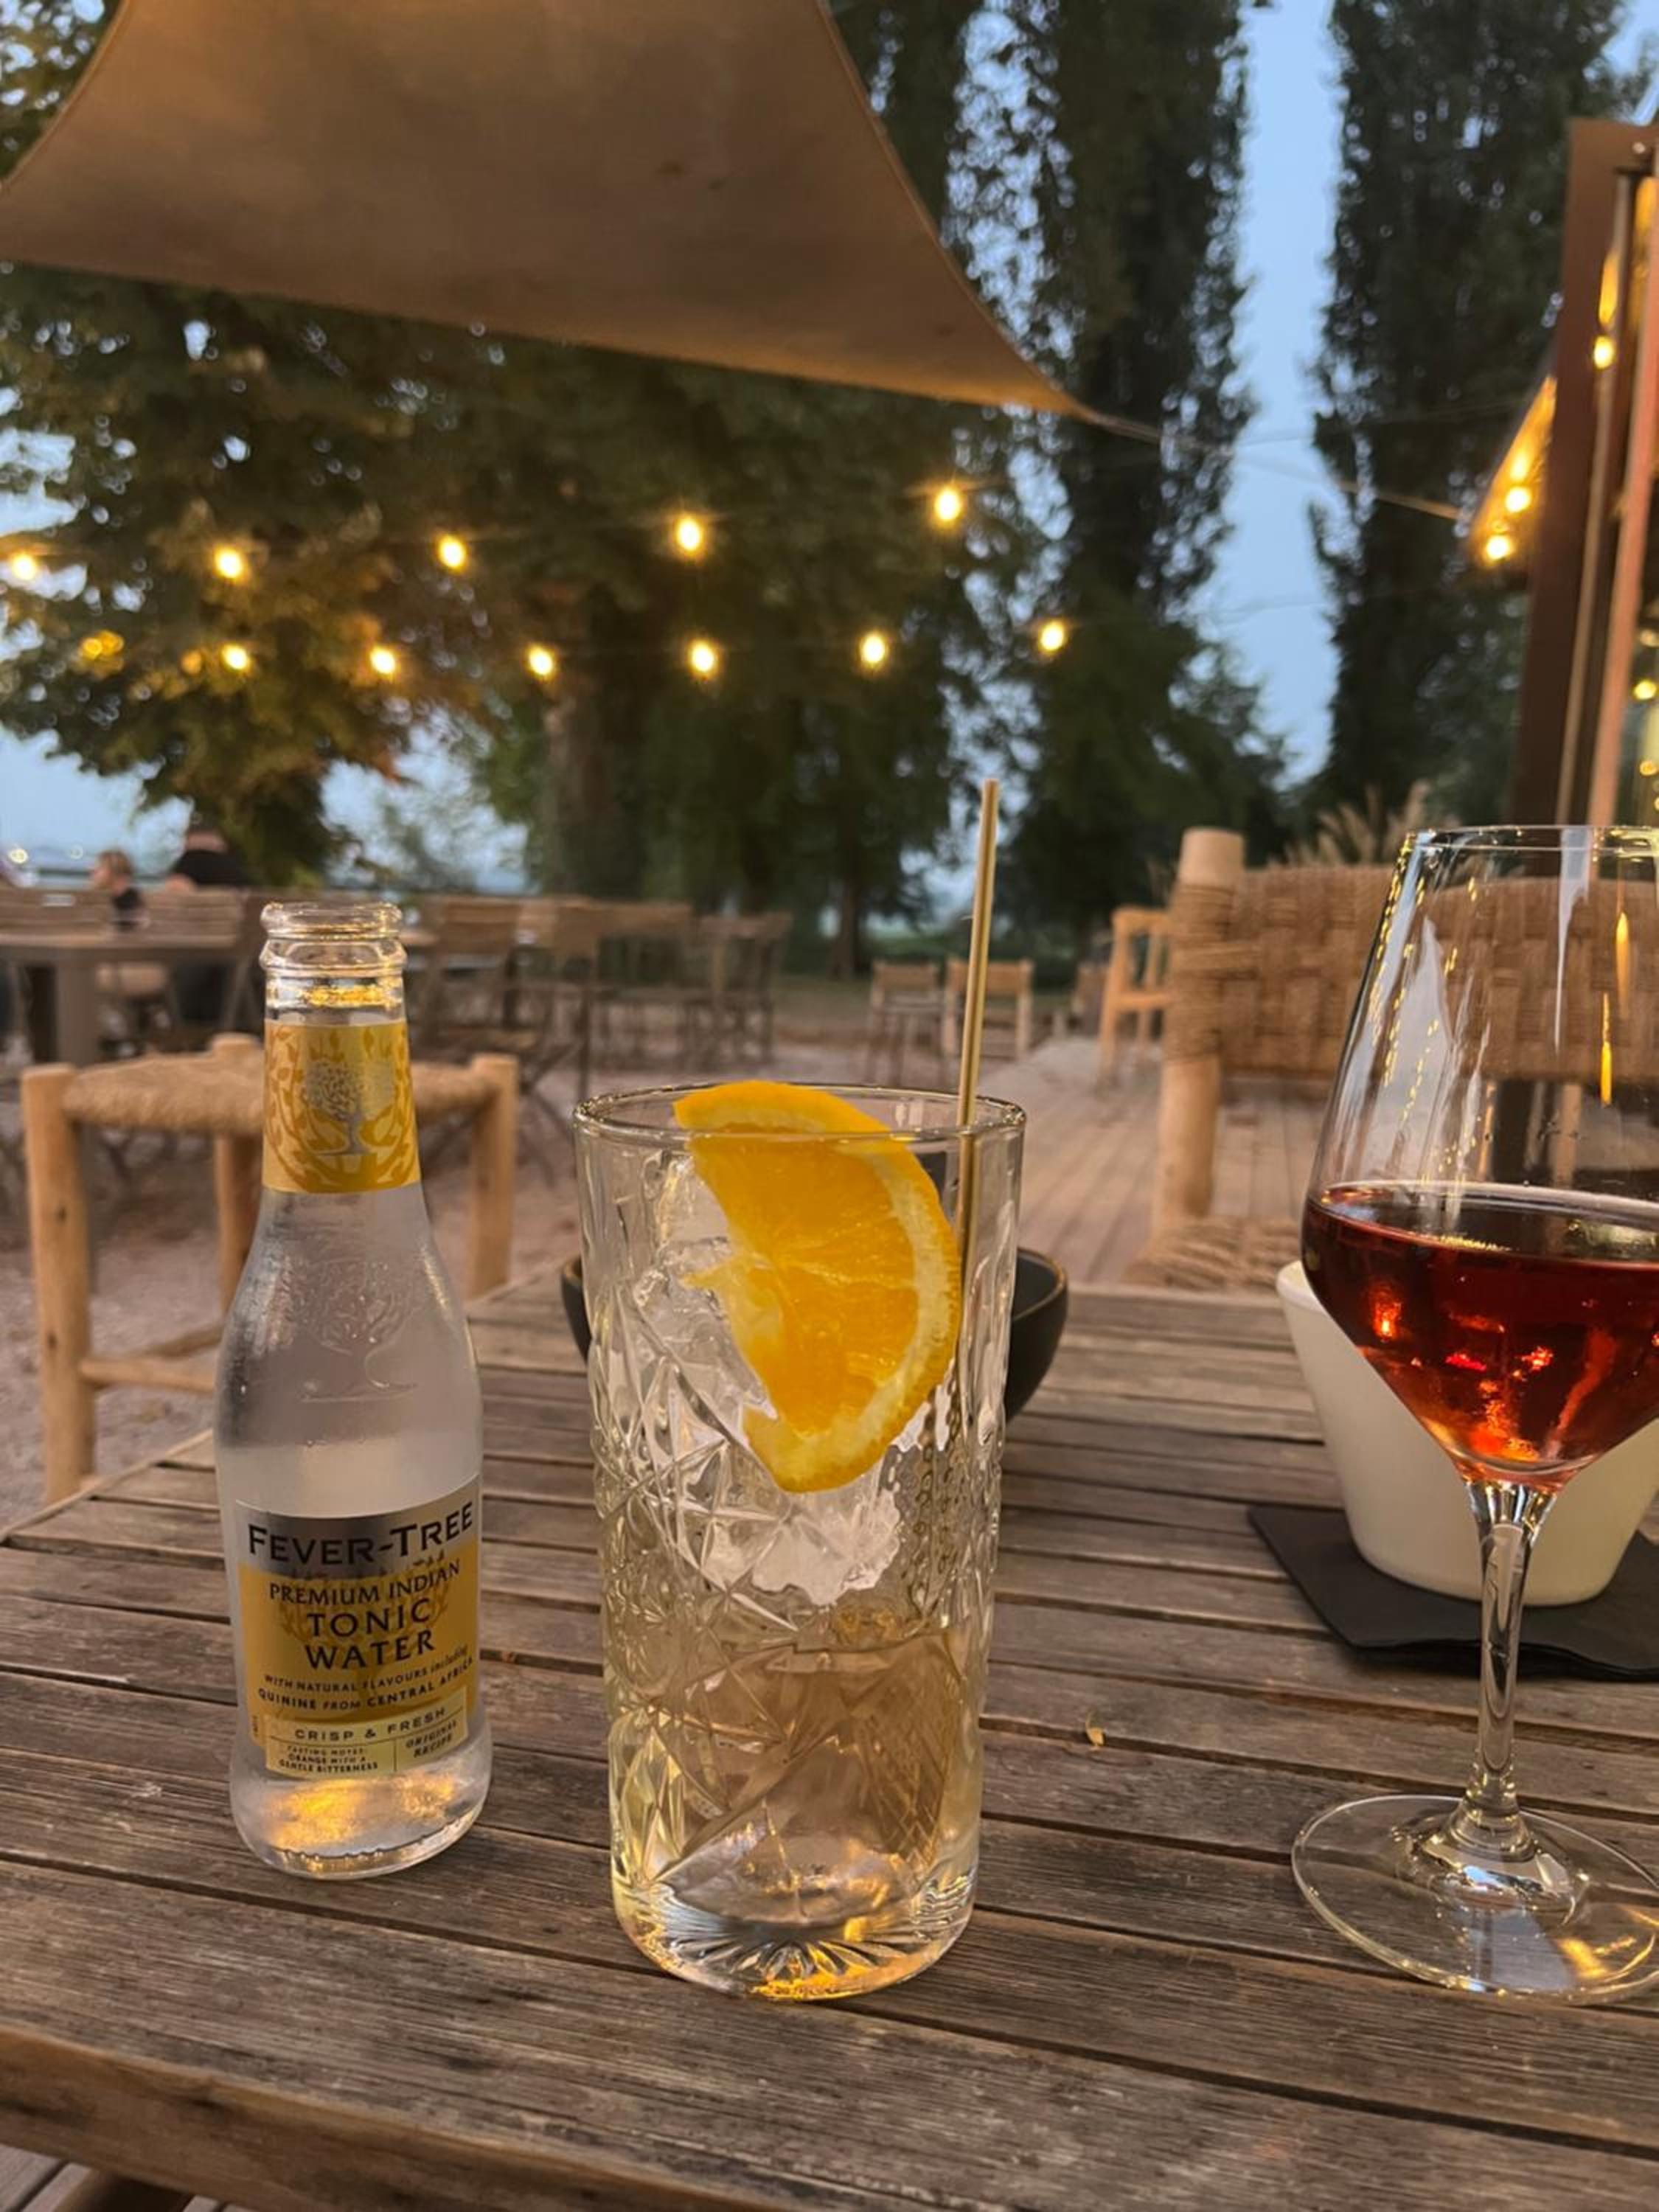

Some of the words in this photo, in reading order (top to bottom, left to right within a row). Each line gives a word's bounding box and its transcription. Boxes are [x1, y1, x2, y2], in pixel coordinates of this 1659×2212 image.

[248, 1501, 473, 1565] FEVER-TREE
[270, 1582, 380, 1605] PREMIUM
[389, 1559, 460, 1599] INDIAN
[307, 1598, 430, 1637] TONIC
[306, 1630, 434, 1670] WATER
[259, 1688, 316, 1710] QUININE
[323, 1700, 361, 1710] FROM
[366, 1682, 435, 1707] CENTRAL
[439, 1657, 473, 1686] AFRICA
[265, 1674, 293, 1688] WITH
[296, 1682, 357, 1692] NATURAL
[362, 1667, 427, 1689] FLAVOURS
[295, 1728, 354, 1741] CRISP
[364, 1728, 376, 1739] &
[388, 1706, 445, 1734] FRESH
